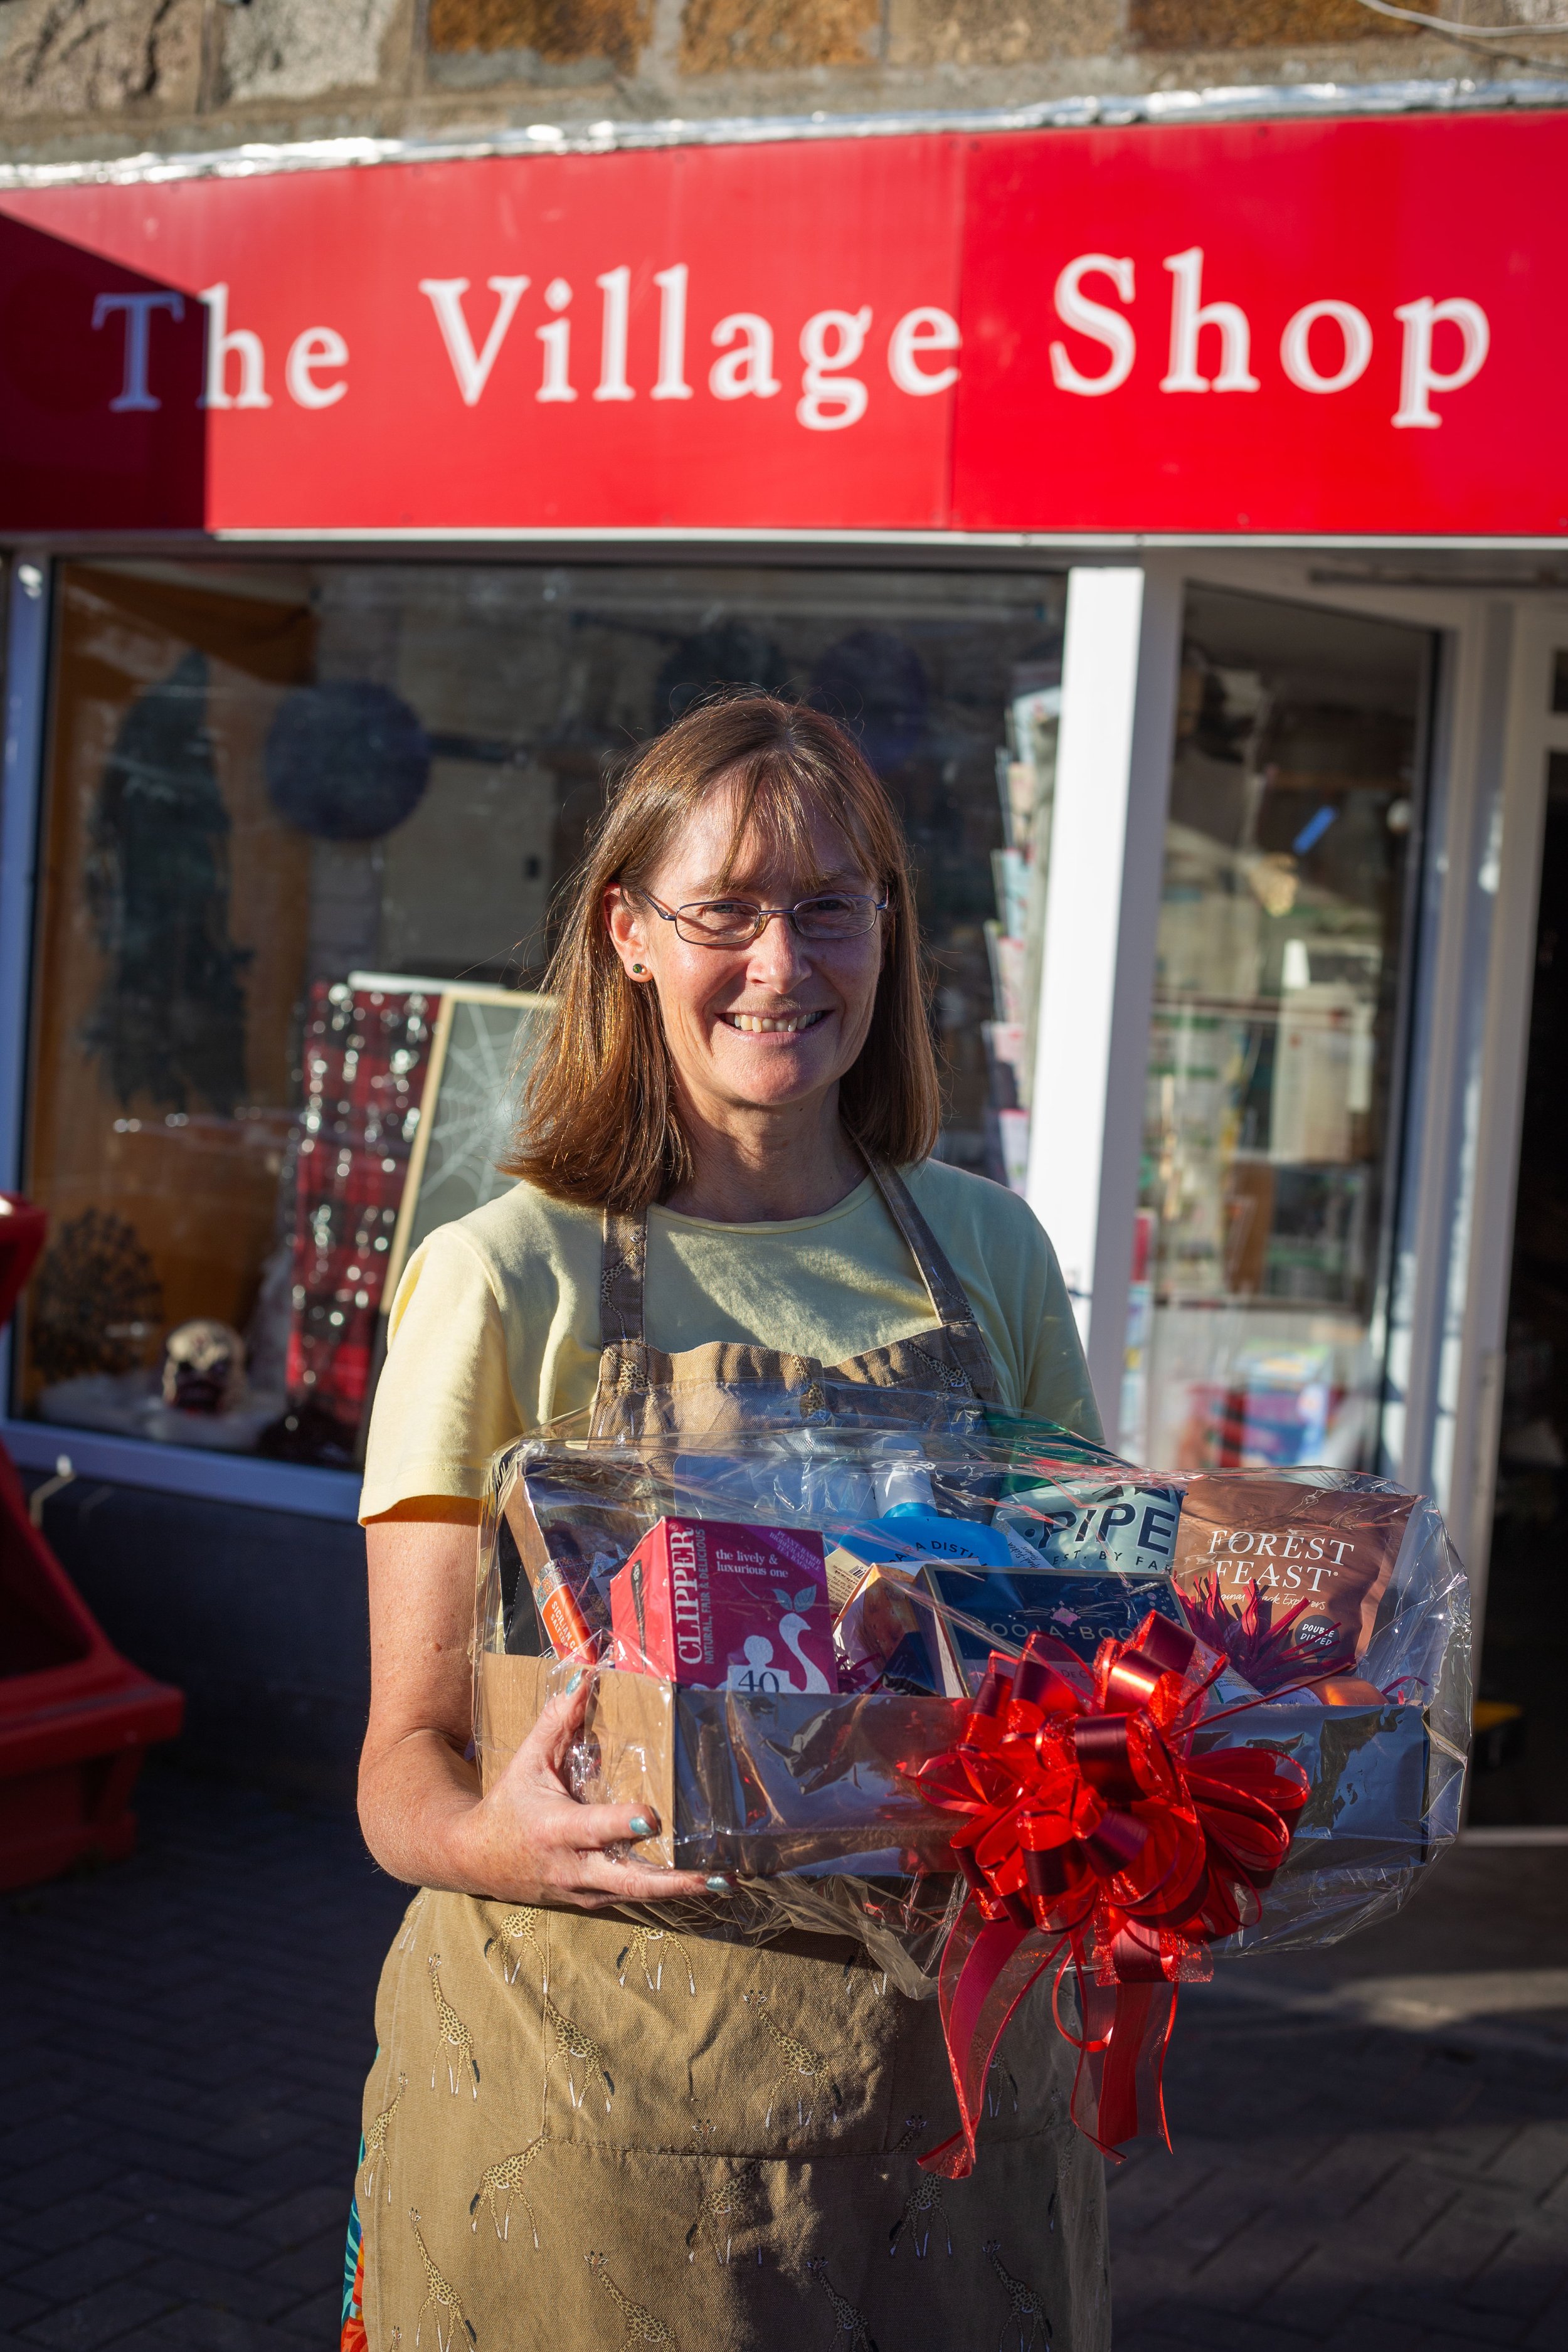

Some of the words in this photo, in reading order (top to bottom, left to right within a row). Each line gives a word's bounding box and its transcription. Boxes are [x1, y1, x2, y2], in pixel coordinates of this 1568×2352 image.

[92, 280, 349, 411] The
[418, 262, 961, 430] Village
[1049, 246, 1492, 429] Shop
[696, 1527, 709, 1579] DELICIOUS
[716, 1549, 733, 1560] the
[737, 1550, 765, 1565] lively
[768, 1554, 778, 1565] &
[776, 1545, 789, 1557] TEA
[1052, 1550, 1086, 1565] EST.
[1099, 1551, 1123, 1561] BY
[1207, 1530, 1355, 1565] FOREST
[716, 1560, 766, 1576] luxurious
[770, 1569, 788, 1578] one
[1216, 1560, 1332, 1592] FEAST
[670, 1527, 702, 1664] CLIPPER
[701, 1592, 711, 1613] FAIR
[550, 1614, 565, 1646] SALTED
[552, 1601, 572, 1641] SICILIAN
[702, 1616, 714, 1665] NATURAL,
[738, 1670, 780, 1693] 40
